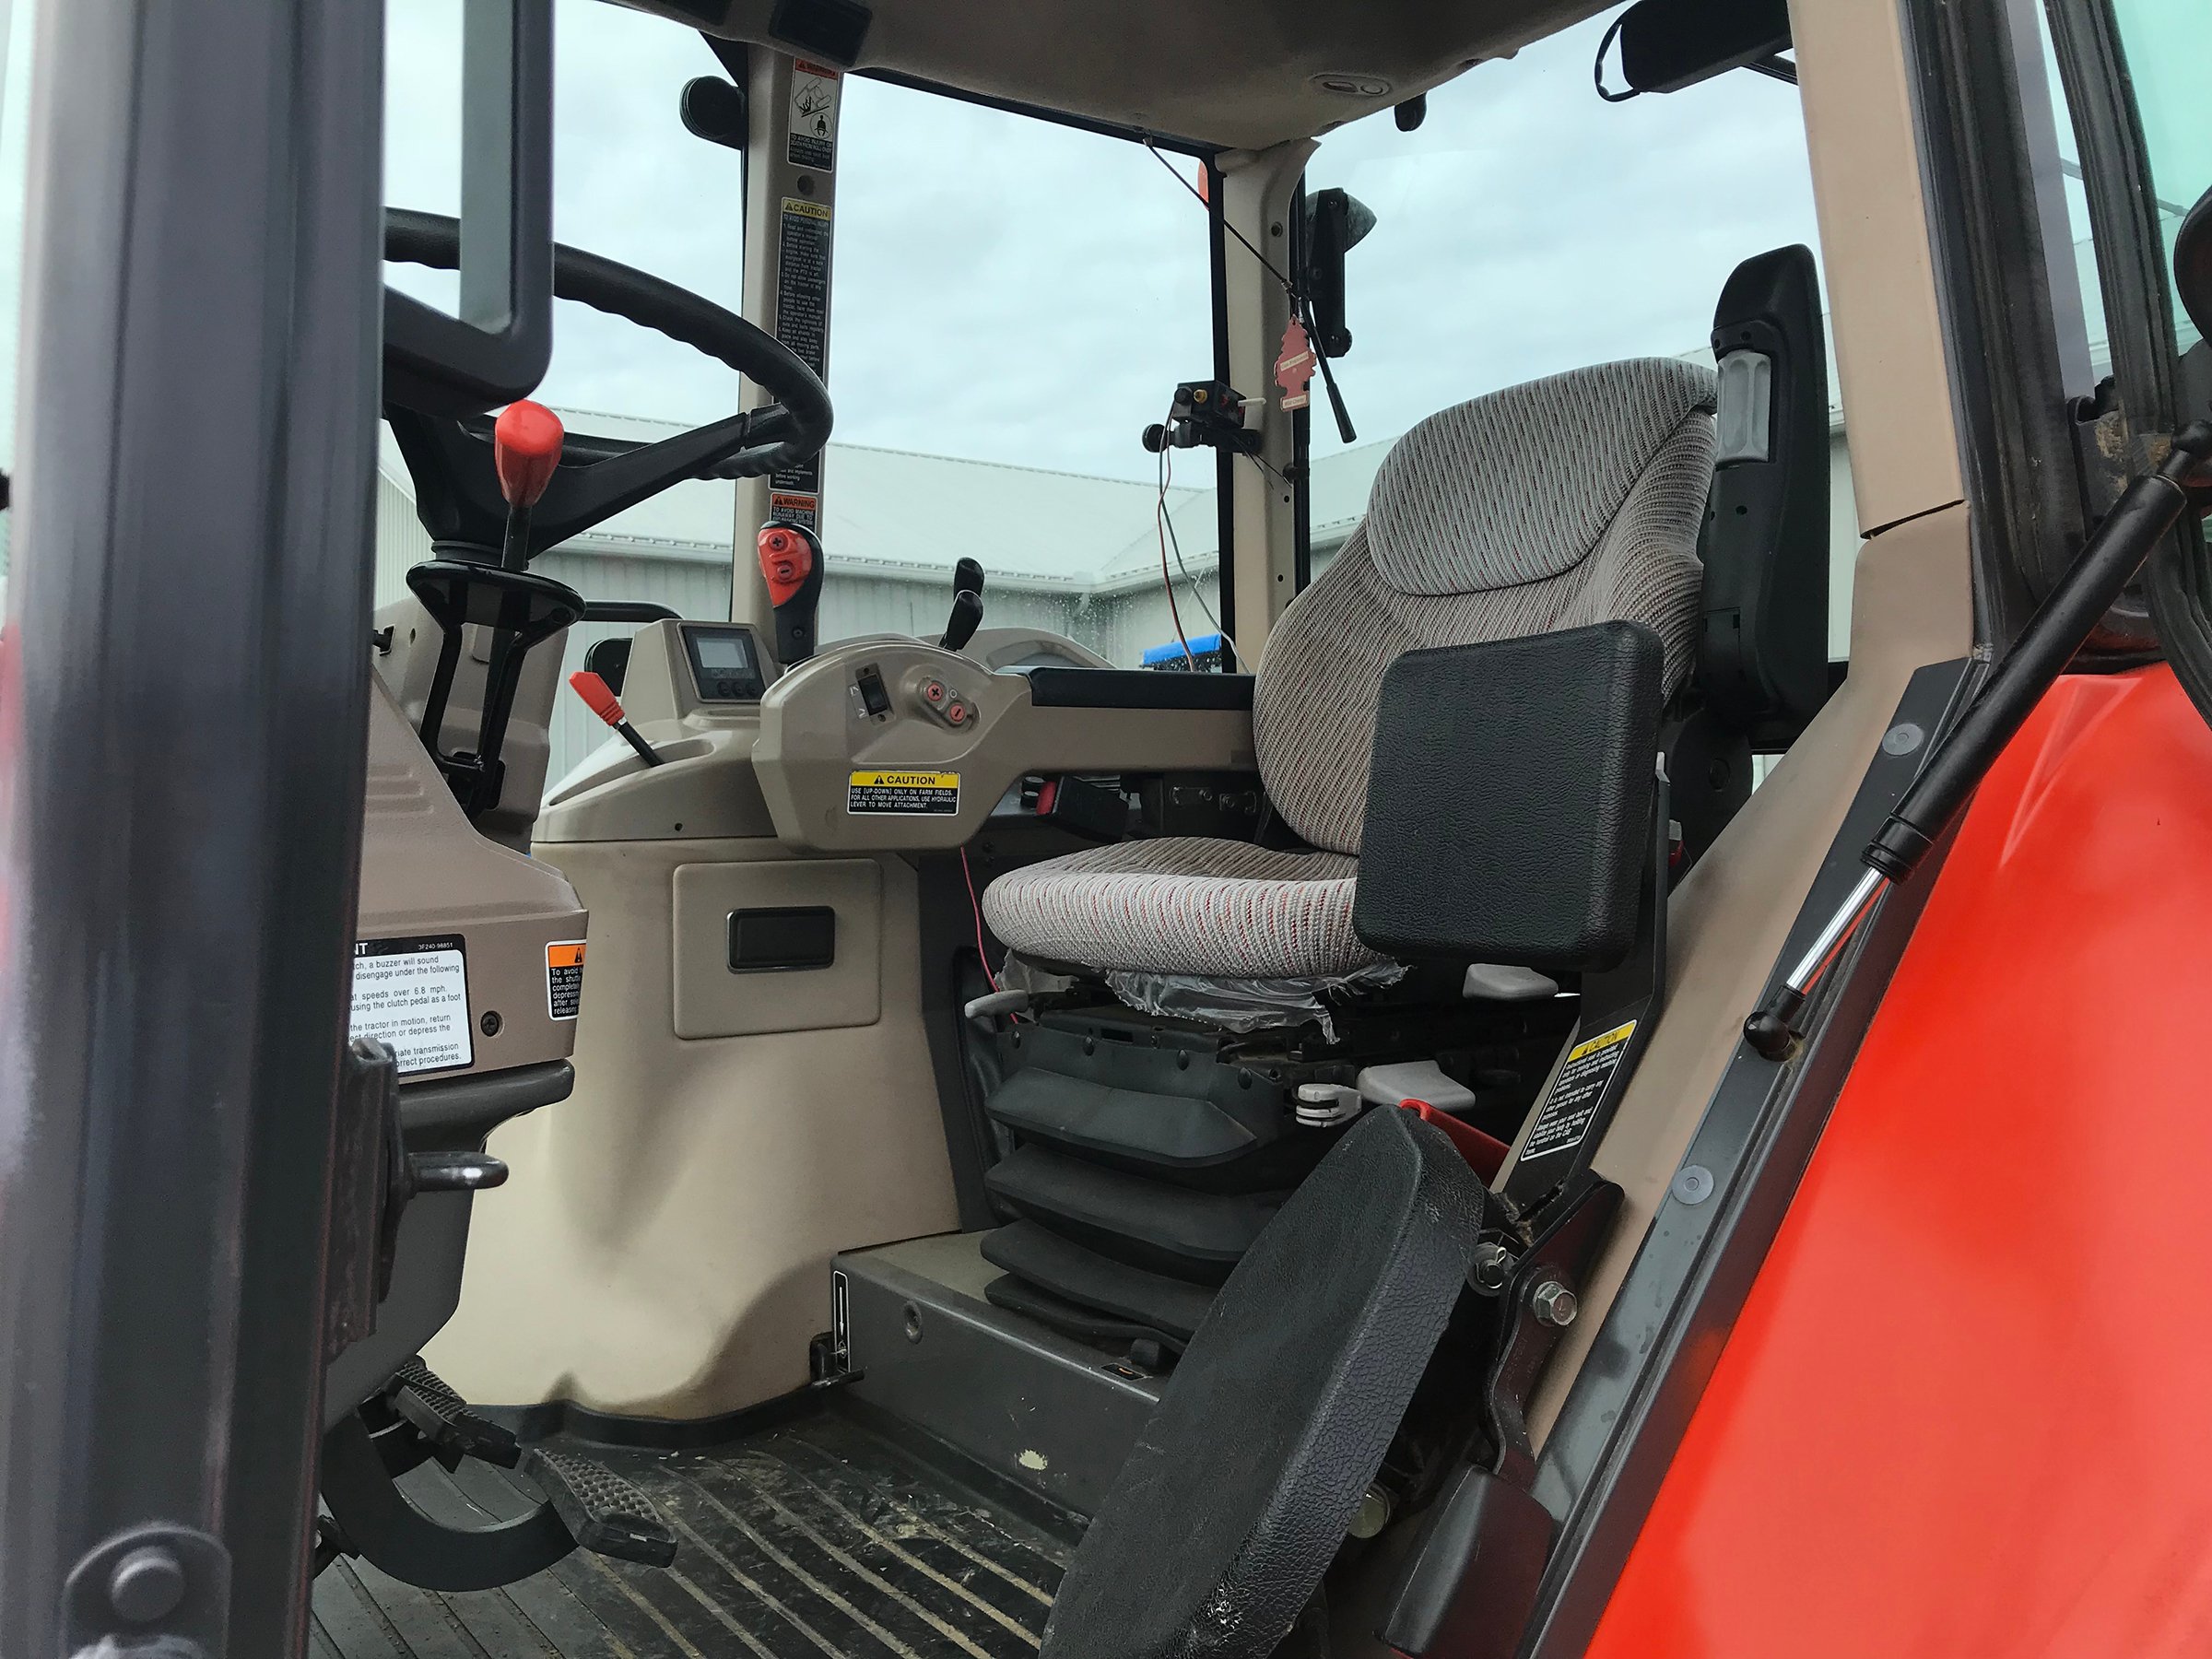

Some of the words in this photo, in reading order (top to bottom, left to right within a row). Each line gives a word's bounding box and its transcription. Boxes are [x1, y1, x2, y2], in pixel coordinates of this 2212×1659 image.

[794, 204, 828, 218] CAUTION
[783, 498, 815, 509] WARNING
[887, 776, 935, 785] CAUTION
[404, 958, 415, 966] will
[418, 956, 439, 964] sound
[356, 970, 393, 980] disengage
[395, 968, 415, 977] under
[429, 964, 460, 973] following
[361, 990, 389, 1001] speeds
[394, 988, 409, 997] over
[415, 986, 426, 995] 6.8
[350, 1003, 371, 1012] using
[373, 1001, 384, 1009] the
[387, 998, 408, 1007] clutch
[410, 995, 429, 1006] pedal
[365, 1020, 389, 1030] tractor
[401, 1018, 428, 1026] motion,
[429, 1015, 451, 1023] return
[364, 1030, 396, 1040] direction
[409, 1025, 437, 1035] depress
[439, 1024, 450, 1032] the
[414, 1042, 459, 1054] transmission
[419, 1053, 461, 1065] procedures.
